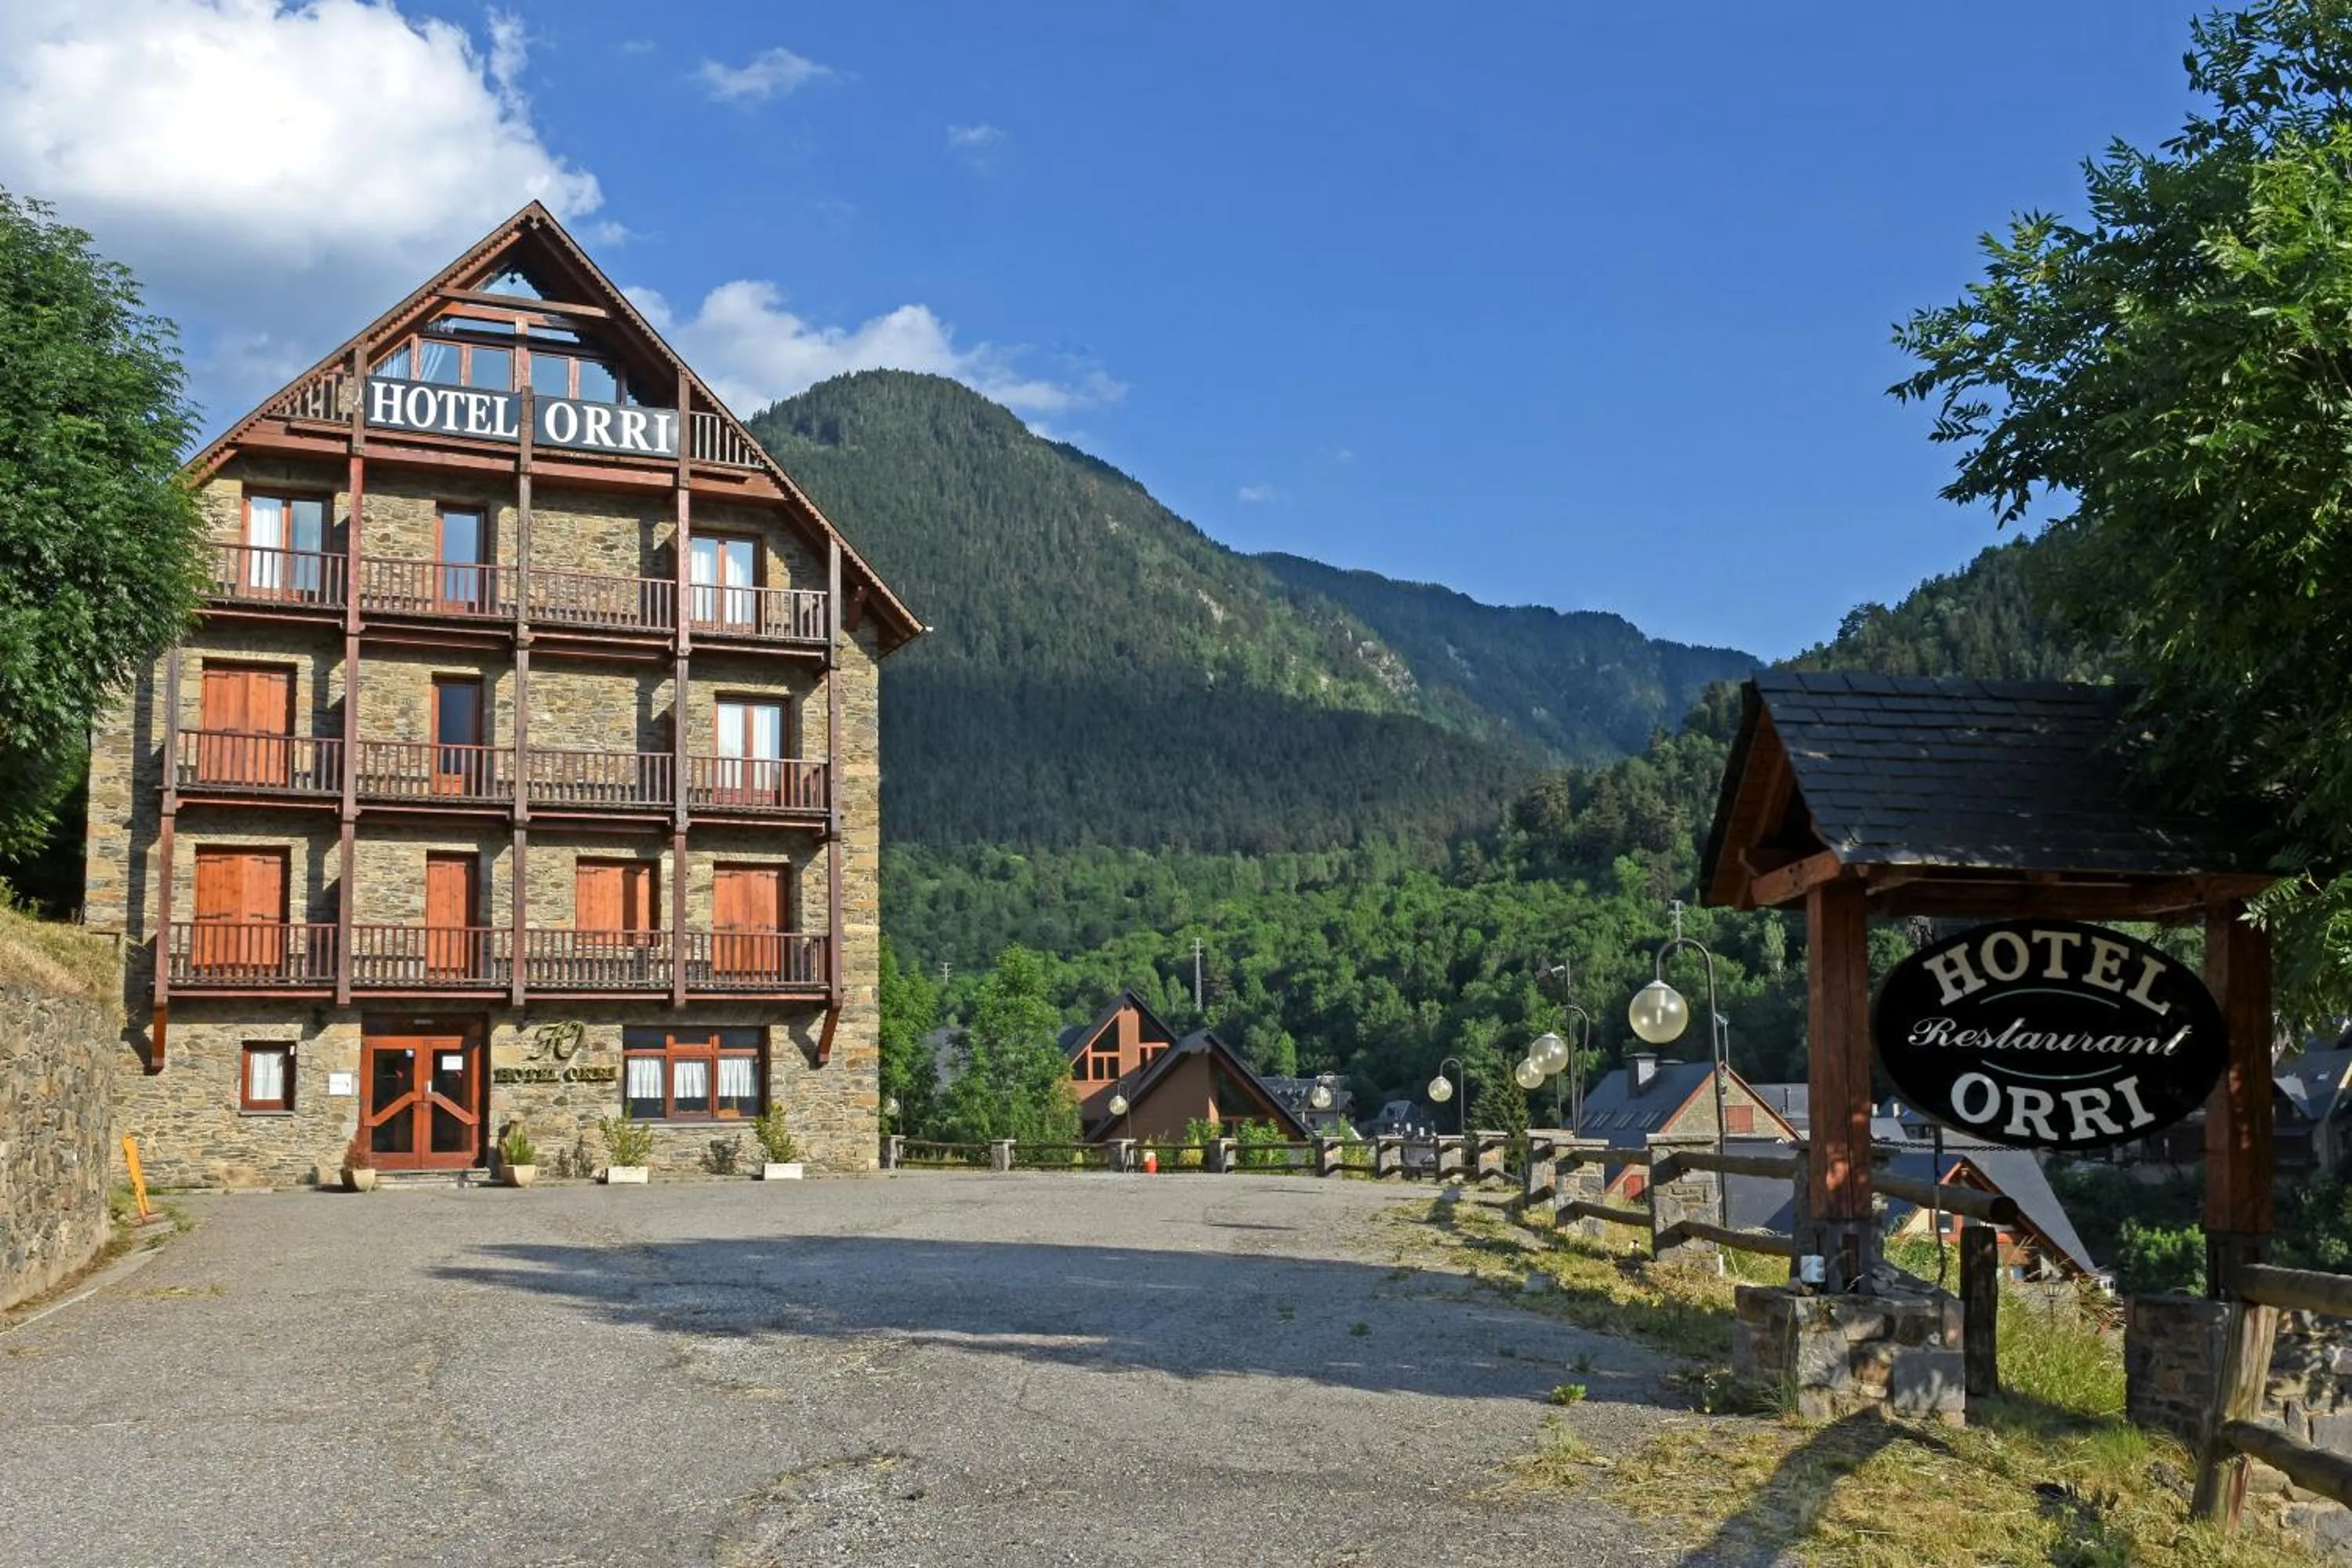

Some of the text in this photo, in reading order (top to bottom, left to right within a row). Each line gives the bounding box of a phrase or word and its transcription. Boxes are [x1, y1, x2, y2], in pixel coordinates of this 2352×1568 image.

[370, 382, 672, 453] HOTEL ORRI
[1922, 930, 2170, 1016] HOTEL
[1908, 1018, 2192, 1056] Restaurant
[1951, 1072, 2155, 1141] ORRI
